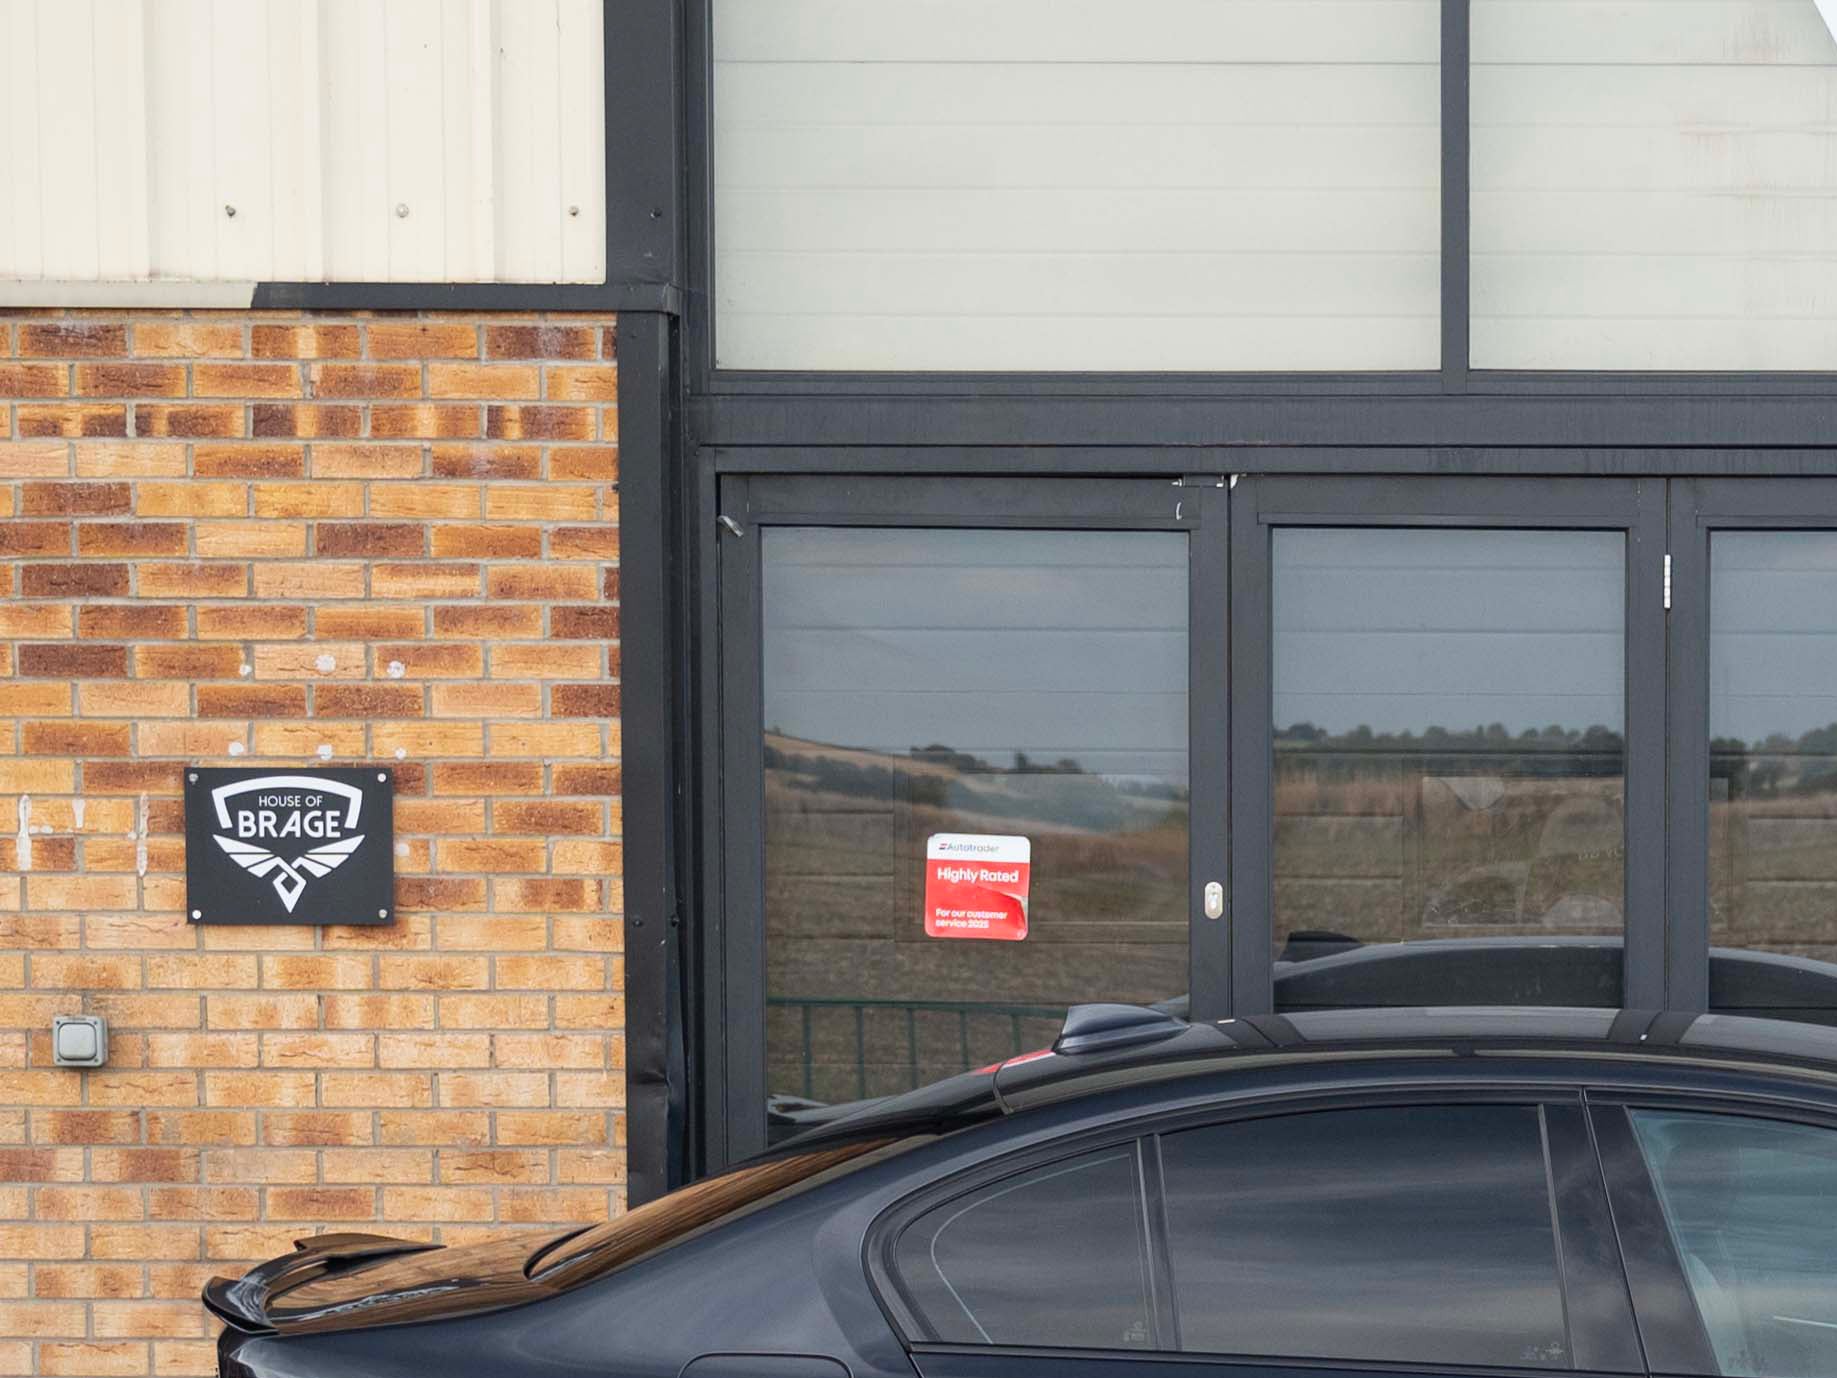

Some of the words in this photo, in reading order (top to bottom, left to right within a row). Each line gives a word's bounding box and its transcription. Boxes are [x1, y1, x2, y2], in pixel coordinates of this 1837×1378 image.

[258, 796, 301, 807] HOUSE
[305, 796, 323, 807] OF
[237, 810, 341, 838] BRAGE
[937, 867, 978, 883] Highly
[980, 869, 1019, 882] Rated
[935, 908, 950, 917] For
[951, 910, 966, 918] our
[967, 910, 1008, 919] customer
[935, 919, 967, 928] service
